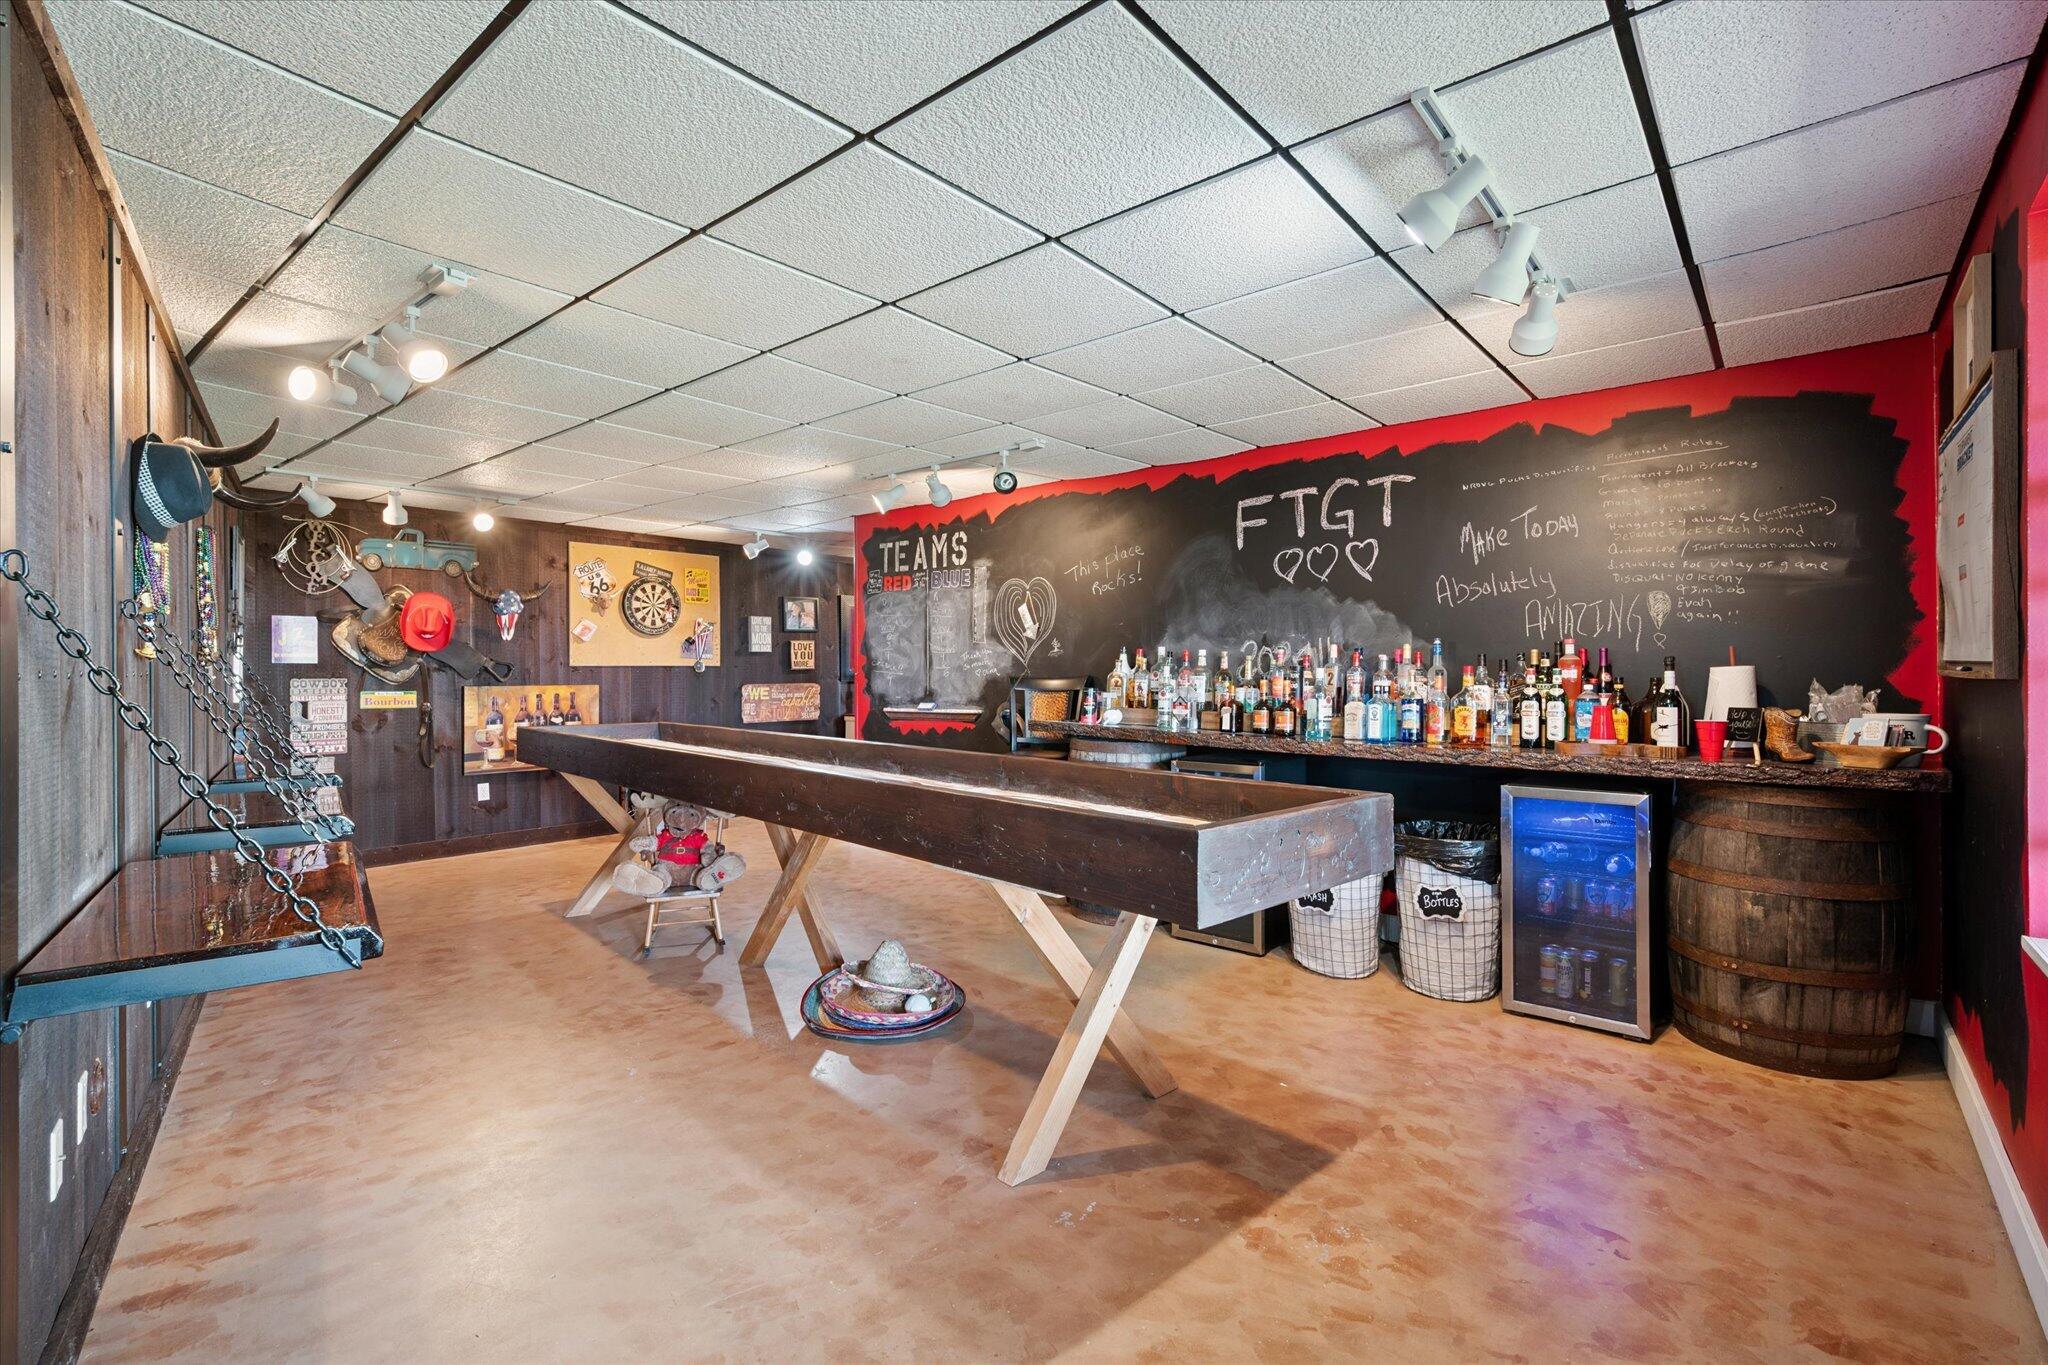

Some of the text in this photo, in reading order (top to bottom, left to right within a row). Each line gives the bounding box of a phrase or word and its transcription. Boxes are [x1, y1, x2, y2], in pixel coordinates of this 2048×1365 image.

[1676, 463, 1695, 474] All
[1700, 460, 1759, 470] Brackets
[1236, 474, 1417, 551] FTGT
[1759, 524, 1805, 537] Round
[879, 531, 968, 573] TEAMS
[578, 560, 604, 576] ROUTE
[1064, 545, 1144, 582] This place
[590, 578, 610, 595] 66
[883, 575, 912, 592] RED
[931, 568, 971, 589] BLUE
[1436, 567, 1558, 609] Absolutely
[1525, 593, 1642, 653] AMAZING
[751, 633, 772, 644] MOON
[793, 642, 813, 651] LOVE
[793, 652, 813, 661] YOU
[291, 679, 346, 689] COWBOY
[364, 697, 415, 706] Bourbon
[311, 706, 345, 715] HONESTY
